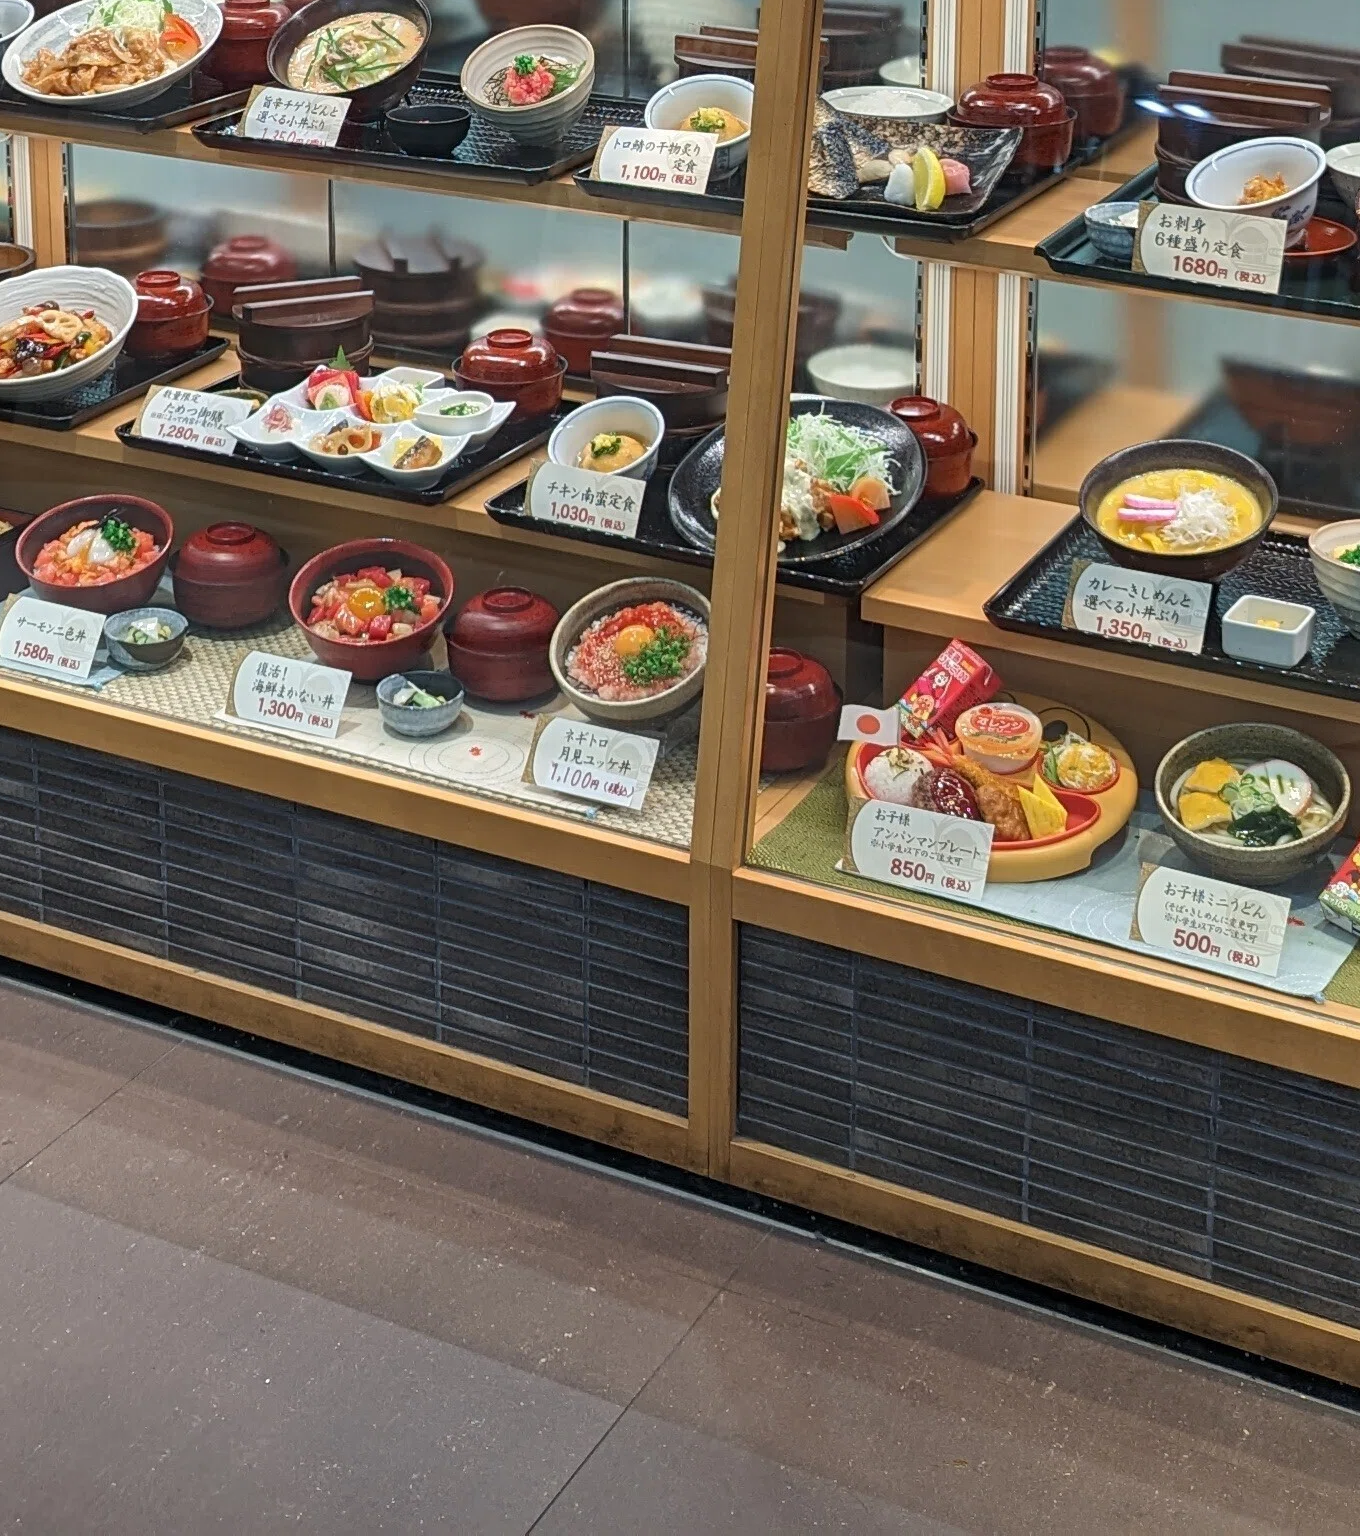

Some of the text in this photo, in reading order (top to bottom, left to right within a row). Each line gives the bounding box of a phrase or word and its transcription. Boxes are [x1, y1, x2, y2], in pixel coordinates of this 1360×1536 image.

[256, 110, 325, 131] 選べる小丼ぶり
[261, 96, 339, 118] 旨辛チゲうどんと
[613, 138, 701, 157] トロ鯖の干物炙り
[620, 164, 698, 185] 1,100円（税込）
[672, 158, 698, 174] 定食
[1159, 213, 1207, 235] お刺身
[1154, 231, 1246, 260] 6種盛り定食
[1172, 254, 1268, 285] 1680円（税込）
[162, 389, 201, 404] 数量限定
[163, 402, 224, 423] ためつ御膳
[547, 481, 636, 513] チキン南蛮定食
[550, 501, 626, 531] 1,030円（税込）
[1089, 577, 1192, 609] カレーきしめんと
[1082, 594, 1180, 625] 選べる小丼ぶり
[16, 615, 88, 643] サーモン二色丼
[13, 639, 81, 671] 1,580円（税込）
[256, 661, 288, 681] 復活！
[251, 678, 335, 710] 海鮮まかない丼
[257, 697, 334, 729] 1,300円（税込）
[565, 728, 609, 748] ネギトロ
[558, 746, 632, 775] 月見ユッケ丼
[874, 807, 911, 827] お子様
[872, 826, 981, 860] アンパンマンプレート
[890, 858, 972, 893] 850円（税込）
[1163, 880, 1267, 920] お子様ミニうどん
[1173, 928, 1260, 968] 500円（税込）
